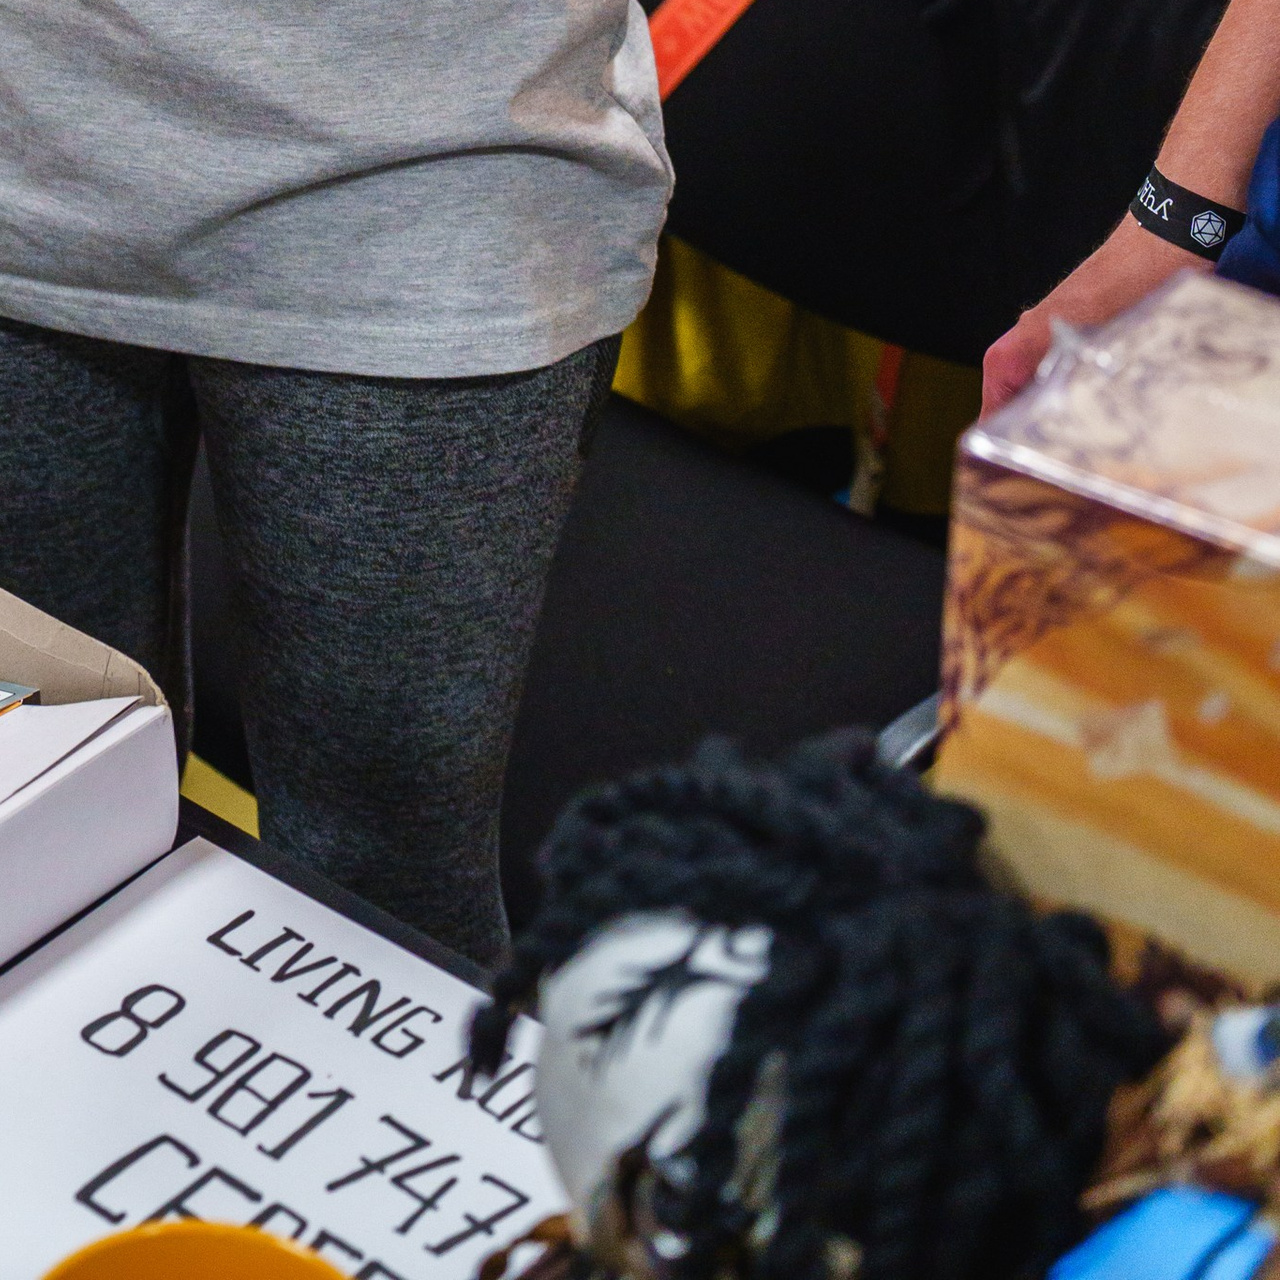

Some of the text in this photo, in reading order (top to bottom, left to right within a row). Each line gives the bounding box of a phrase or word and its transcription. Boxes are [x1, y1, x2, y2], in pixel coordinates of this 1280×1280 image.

[206, 909, 442, 1059] LIVING
[80, 983, 531, 1257] 8 981 747
